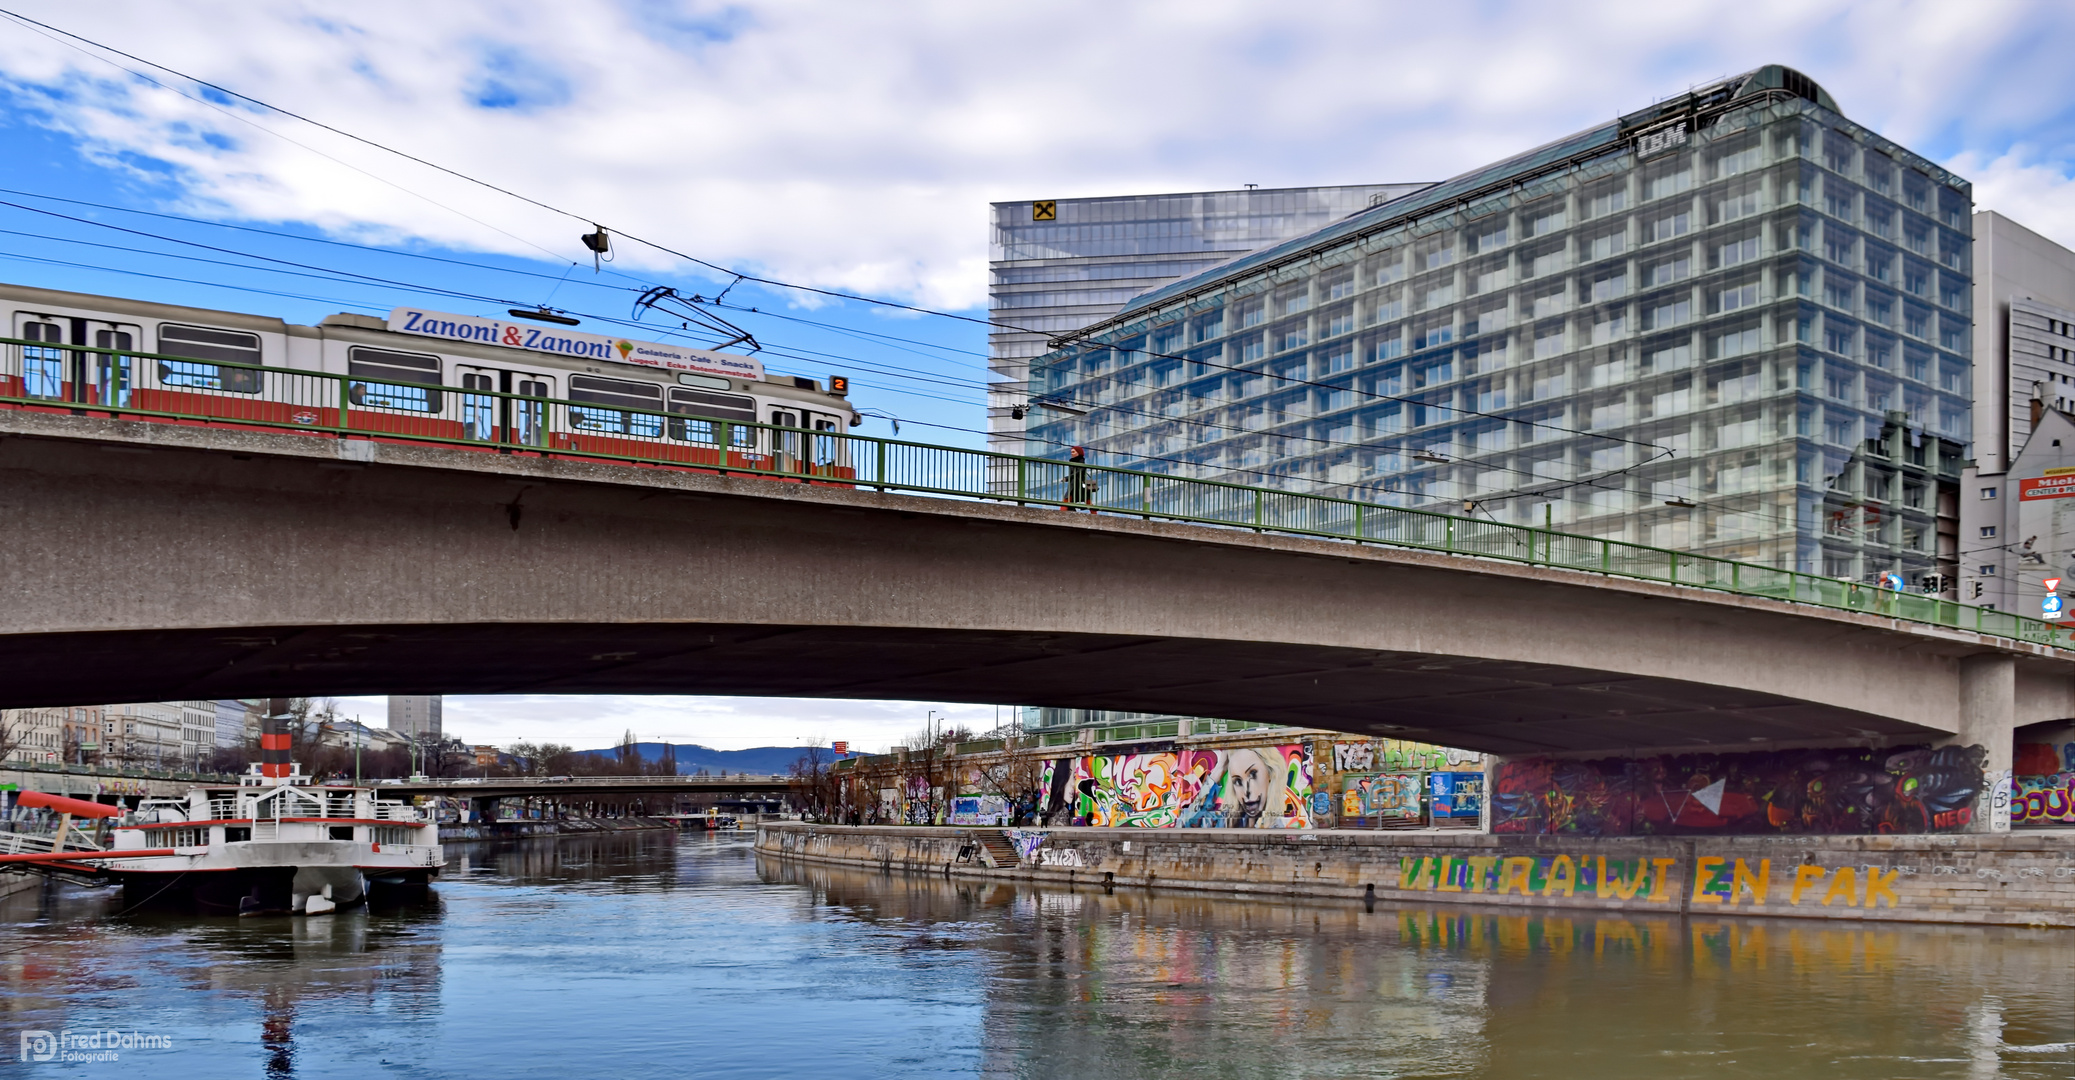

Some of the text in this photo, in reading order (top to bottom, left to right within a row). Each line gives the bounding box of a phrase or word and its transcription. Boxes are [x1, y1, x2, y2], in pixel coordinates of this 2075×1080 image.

[1637, 121, 1687, 158] IBM
[403, 311, 612, 359] Zanoni & Zanoni
[628, 356, 659, 366] Lugeck
[666, 361, 688, 370] Ecke
[636, 347, 682, 360] Gelateria
[721, 358, 755, 370] Snacks
[834, 378, 845, 389] 2
[2027, 487, 2058, 497] CENTER
[2023, 621, 2042, 631] Ihr
[1934, 806, 1972, 829] NEO
[1790, 864, 1899, 909] FAK
